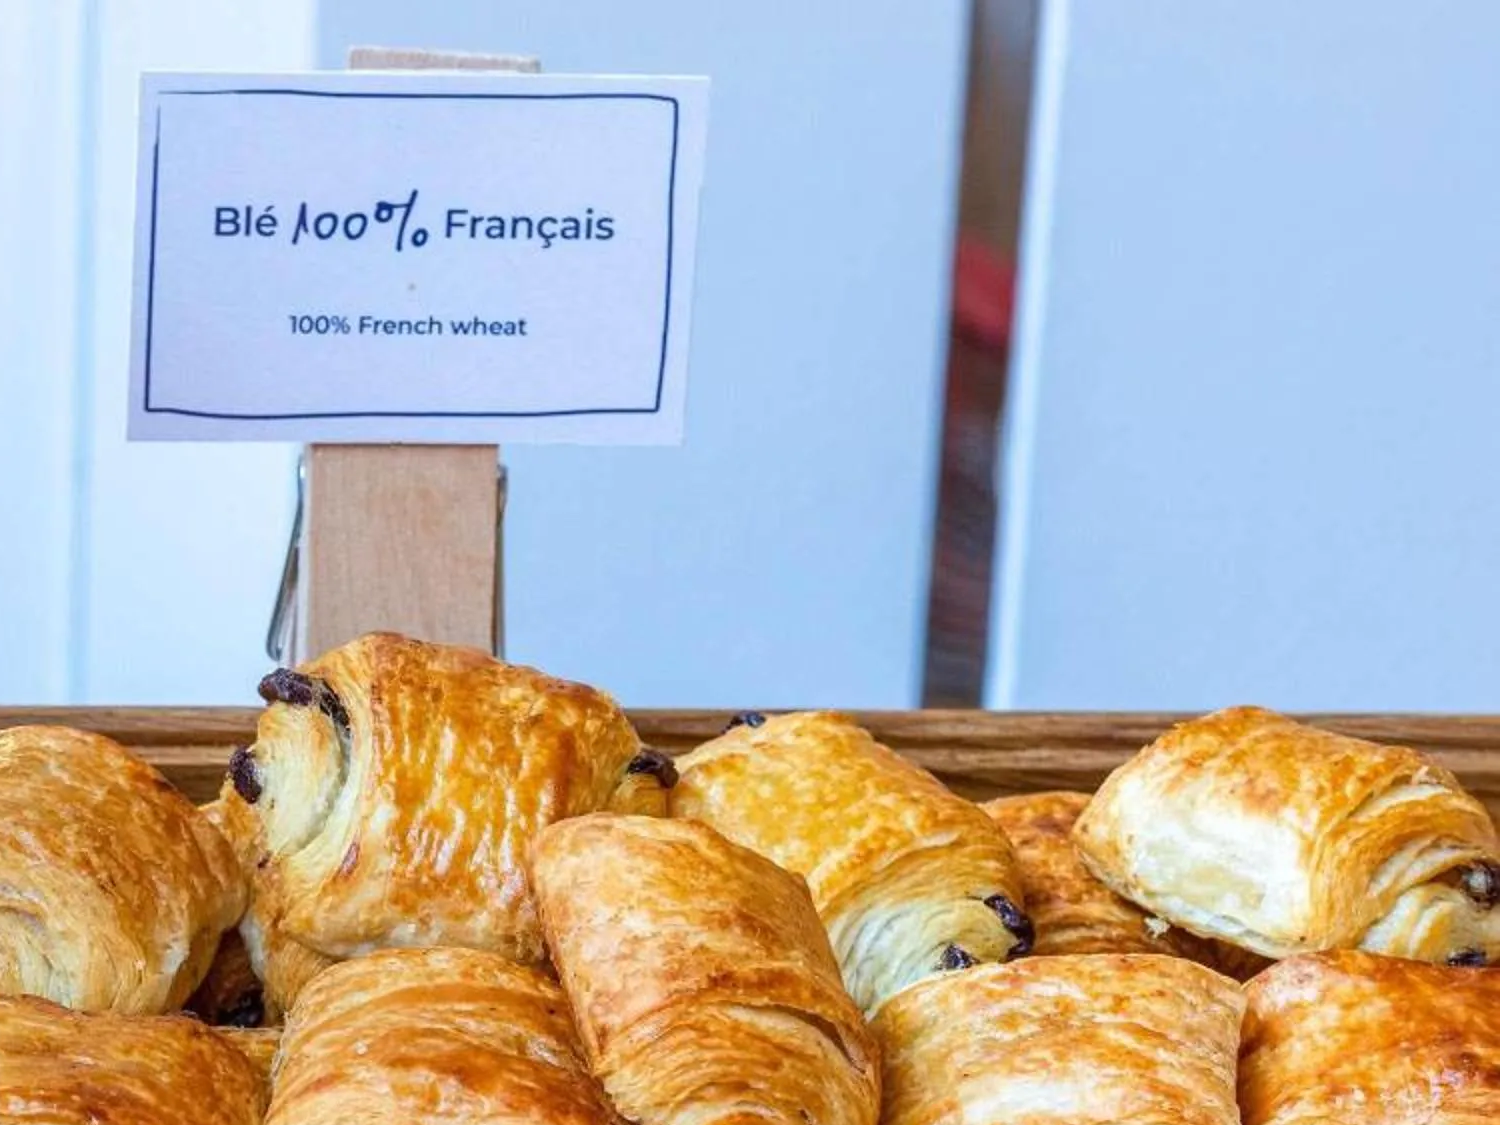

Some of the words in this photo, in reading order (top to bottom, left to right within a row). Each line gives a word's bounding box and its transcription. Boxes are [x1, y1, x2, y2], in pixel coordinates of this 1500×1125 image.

[214, 204, 279, 238] Blé
[291, 189, 429, 252] 100%
[444, 207, 616, 249] Français
[289, 314, 351, 335] 100%
[357, 314, 443, 336] French
[450, 315, 528, 337] wheat
